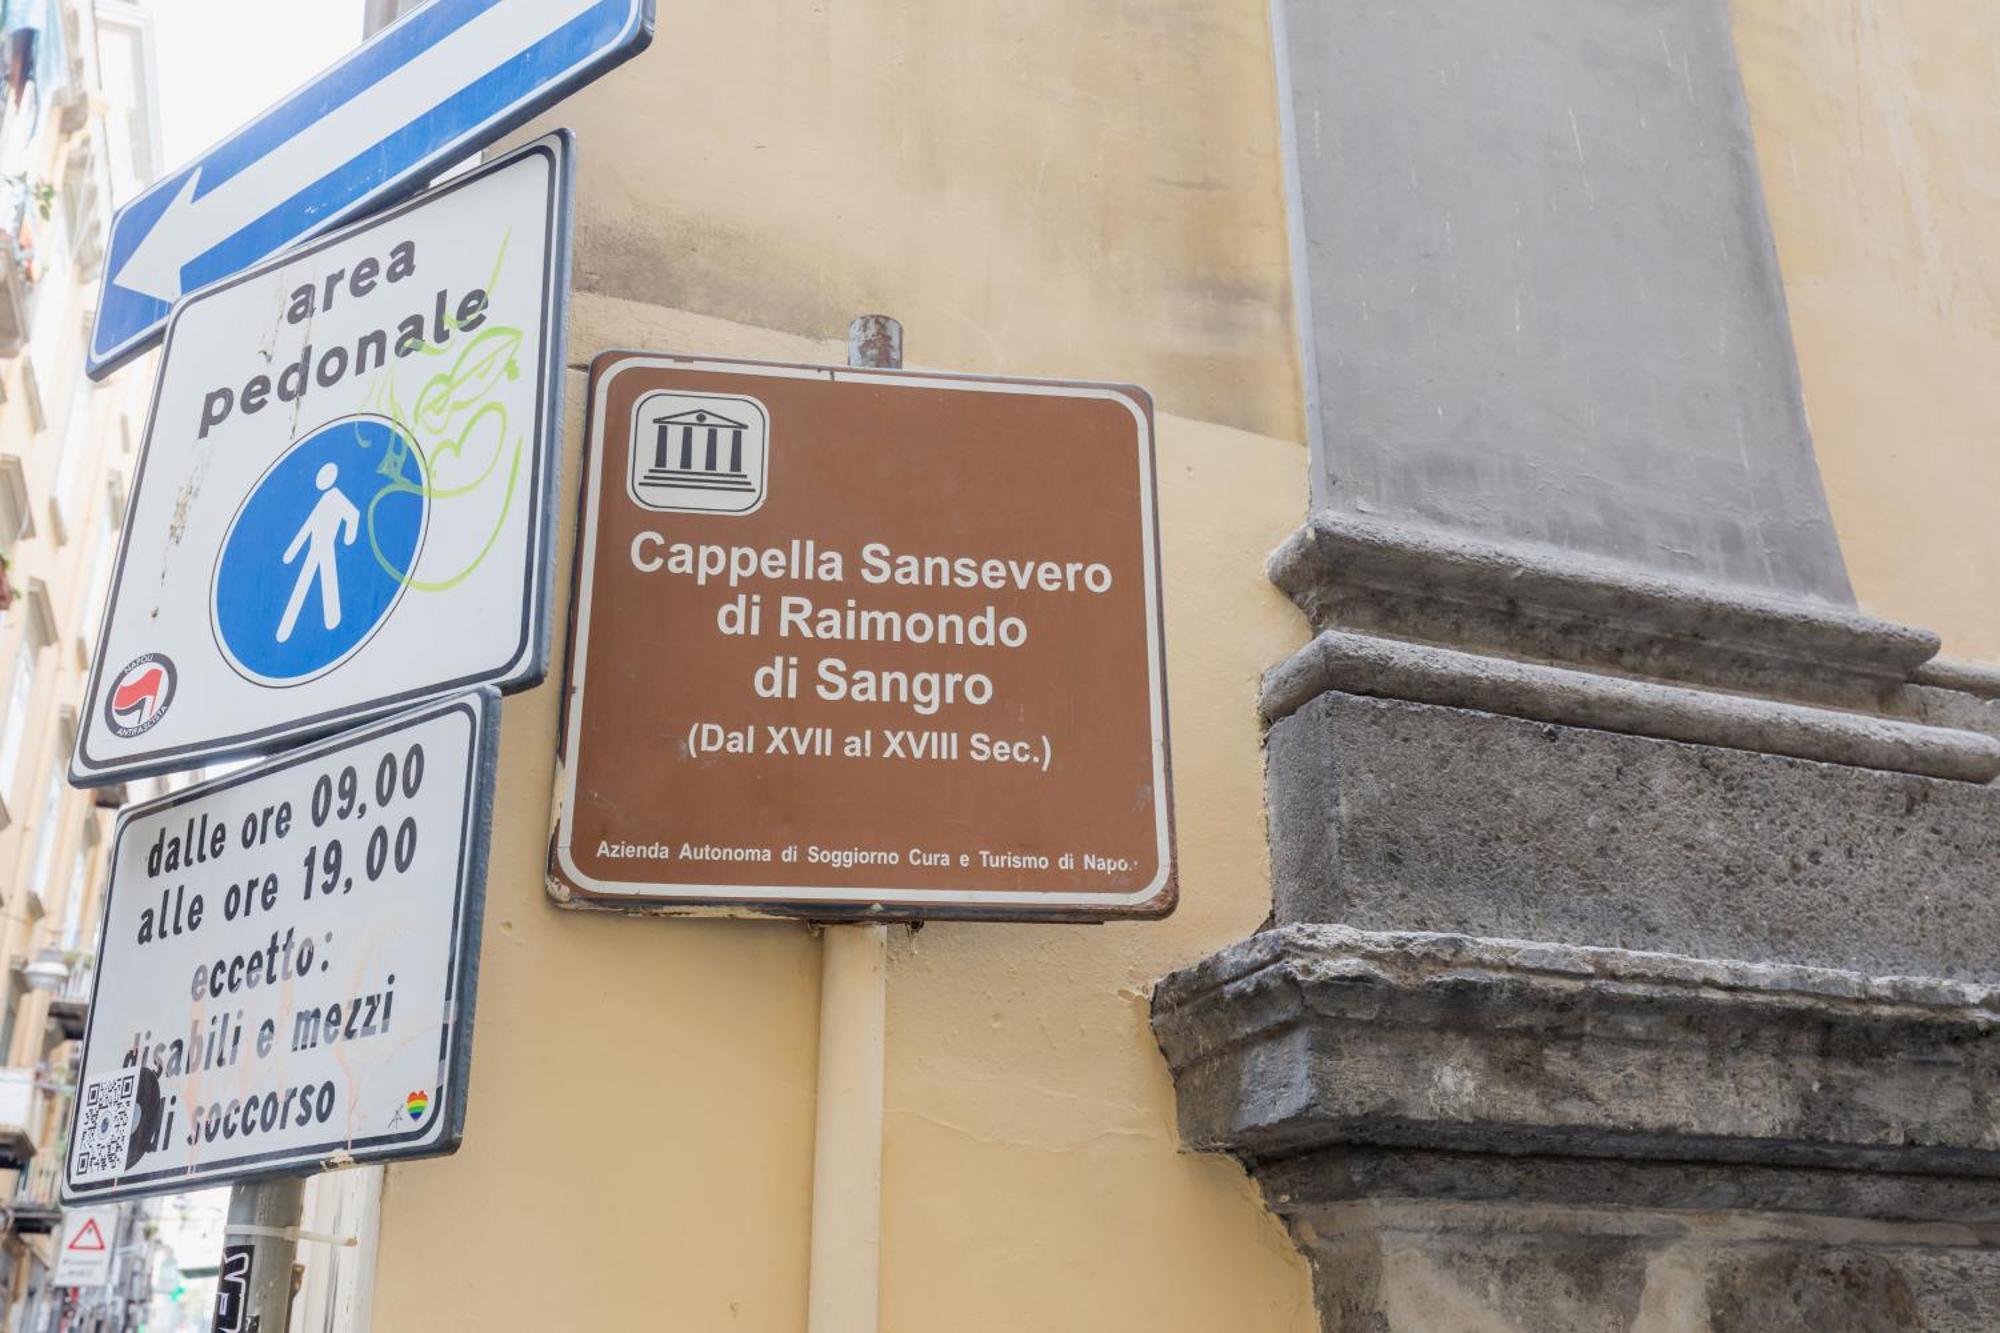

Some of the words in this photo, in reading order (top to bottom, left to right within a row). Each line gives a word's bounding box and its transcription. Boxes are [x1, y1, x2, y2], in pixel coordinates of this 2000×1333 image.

[287, 240, 416, 325] area
[198, 288, 489, 440] pedonale
[630, 530, 844, 587] Cappella
[860, 541, 1113, 594] Sansevero
[716, 594, 761, 636] di
[779, 595, 1028, 648] Raimondo
[753, 655, 799, 699] di
[815, 657, 994, 716] Sangro
[117, 705, 168, 737] ANTIFASCISTA
[688, 722, 755, 759] (Dal
[765, 725, 833, 757] XVII
[843, 729, 872, 758] al
[882, 729, 959, 761] XVIII
[969, 732, 1053, 772] Sec.)
[147, 813, 227, 878] dalle
[241, 801, 292, 850] ore
[311, 743, 425, 828] 09,00
[137, 884, 204, 946] alle
[224, 872, 279, 922] ore
[303, 816, 418, 901] 19,00
[596, 840, 669, 861] Azienda
[678, 842, 772, 863] Autonoma
[780, 844, 798, 863] di
[807, 845, 900, 869] Soggiorno
[908, 848, 951, 867] Cura
[959, 853, 970, 868] e
[979, 850, 1050, 870] Turismo
[1058, 853, 1075, 870] di
[191, 927, 333, 1001] eccetto:
[256, 1018, 275, 1058] e
[291, 973, 396, 1055] mezzi
[187, 1079, 336, 1147] soccorso
